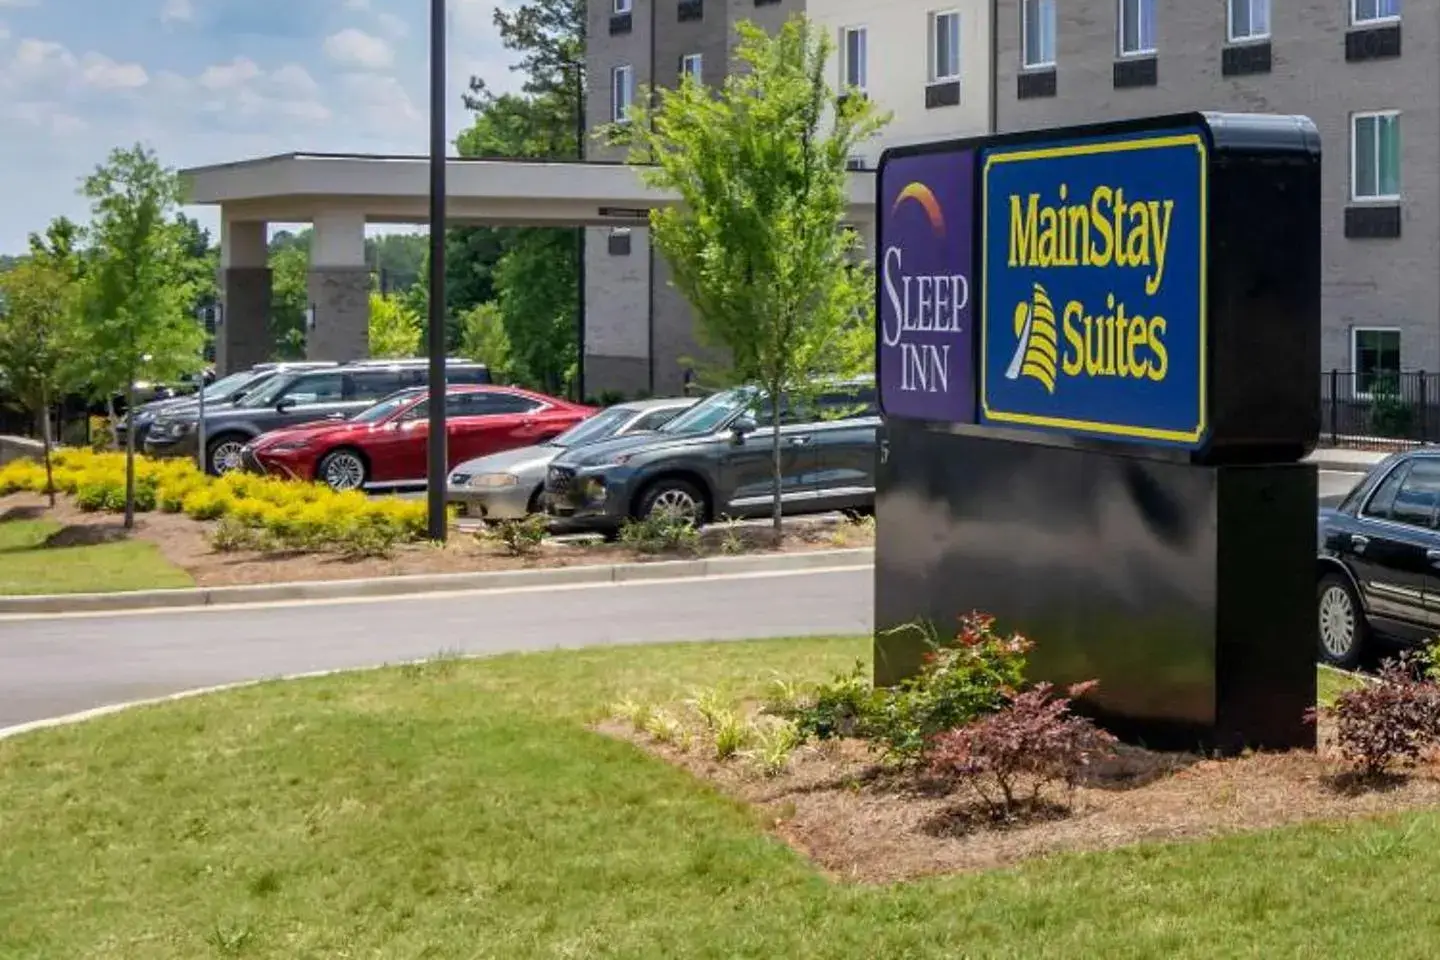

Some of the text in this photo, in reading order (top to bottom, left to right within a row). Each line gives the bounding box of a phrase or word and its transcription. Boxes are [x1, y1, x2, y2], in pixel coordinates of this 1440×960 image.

[1007, 183, 1174, 296] MainStay
[882, 245, 969, 347] SLEEP
[1062, 293, 1169, 381] Suites
[900, 342, 950, 393] INN
